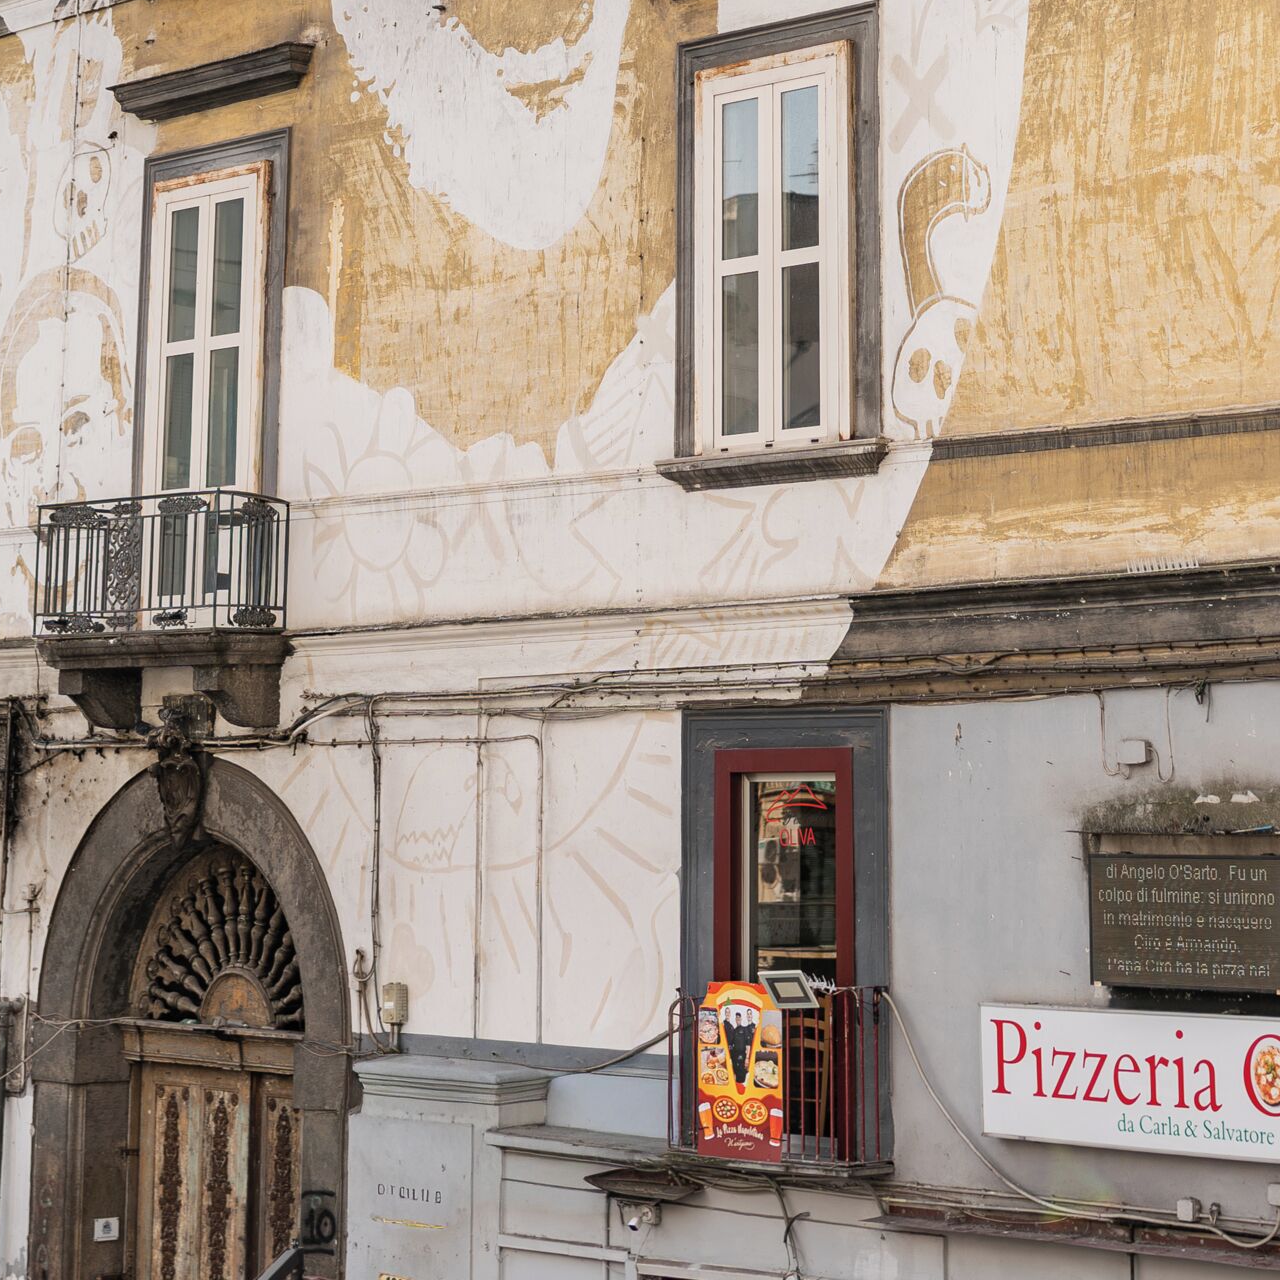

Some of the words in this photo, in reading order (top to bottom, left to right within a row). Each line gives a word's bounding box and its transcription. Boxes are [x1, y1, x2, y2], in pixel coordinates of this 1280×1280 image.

[780, 827, 816, 847] OLIVA
[1106, 864, 1117, 879] di
[1120, 864, 1165, 882] Angelo
[1169, 864, 1221, 881] O'Sarto.
[1229, 865, 1246, 881] Fu
[1250, 867, 1267, 881] un
[1098, 888, 1133, 905] colpo
[1137, 888, 1150, 903] di
[1151, 887, 1204, 904] fulmine:
[1208, 888, 1220, 904] si
[1224, 888, 1275, 906] unirono
[1103, 910, 1115, 926] in
[1118, 910, 1193, 928] matrimonio
[1196, 916, 1205, 928] e
[1208, 916, 1272, 930] nacquero
[1134, 934, 1161, 950] Ciro
[1165, 938, 1173, 951] e
[990, 1018, 1223, 1113] Pizzeria
[1117, 1114, 1135, 1133] da
[1139, 1114, 1181, 1137] Carla
[1184, 1120, 1199, 1138] &
[1203, 1119, 1275, 1146] Salvatore
